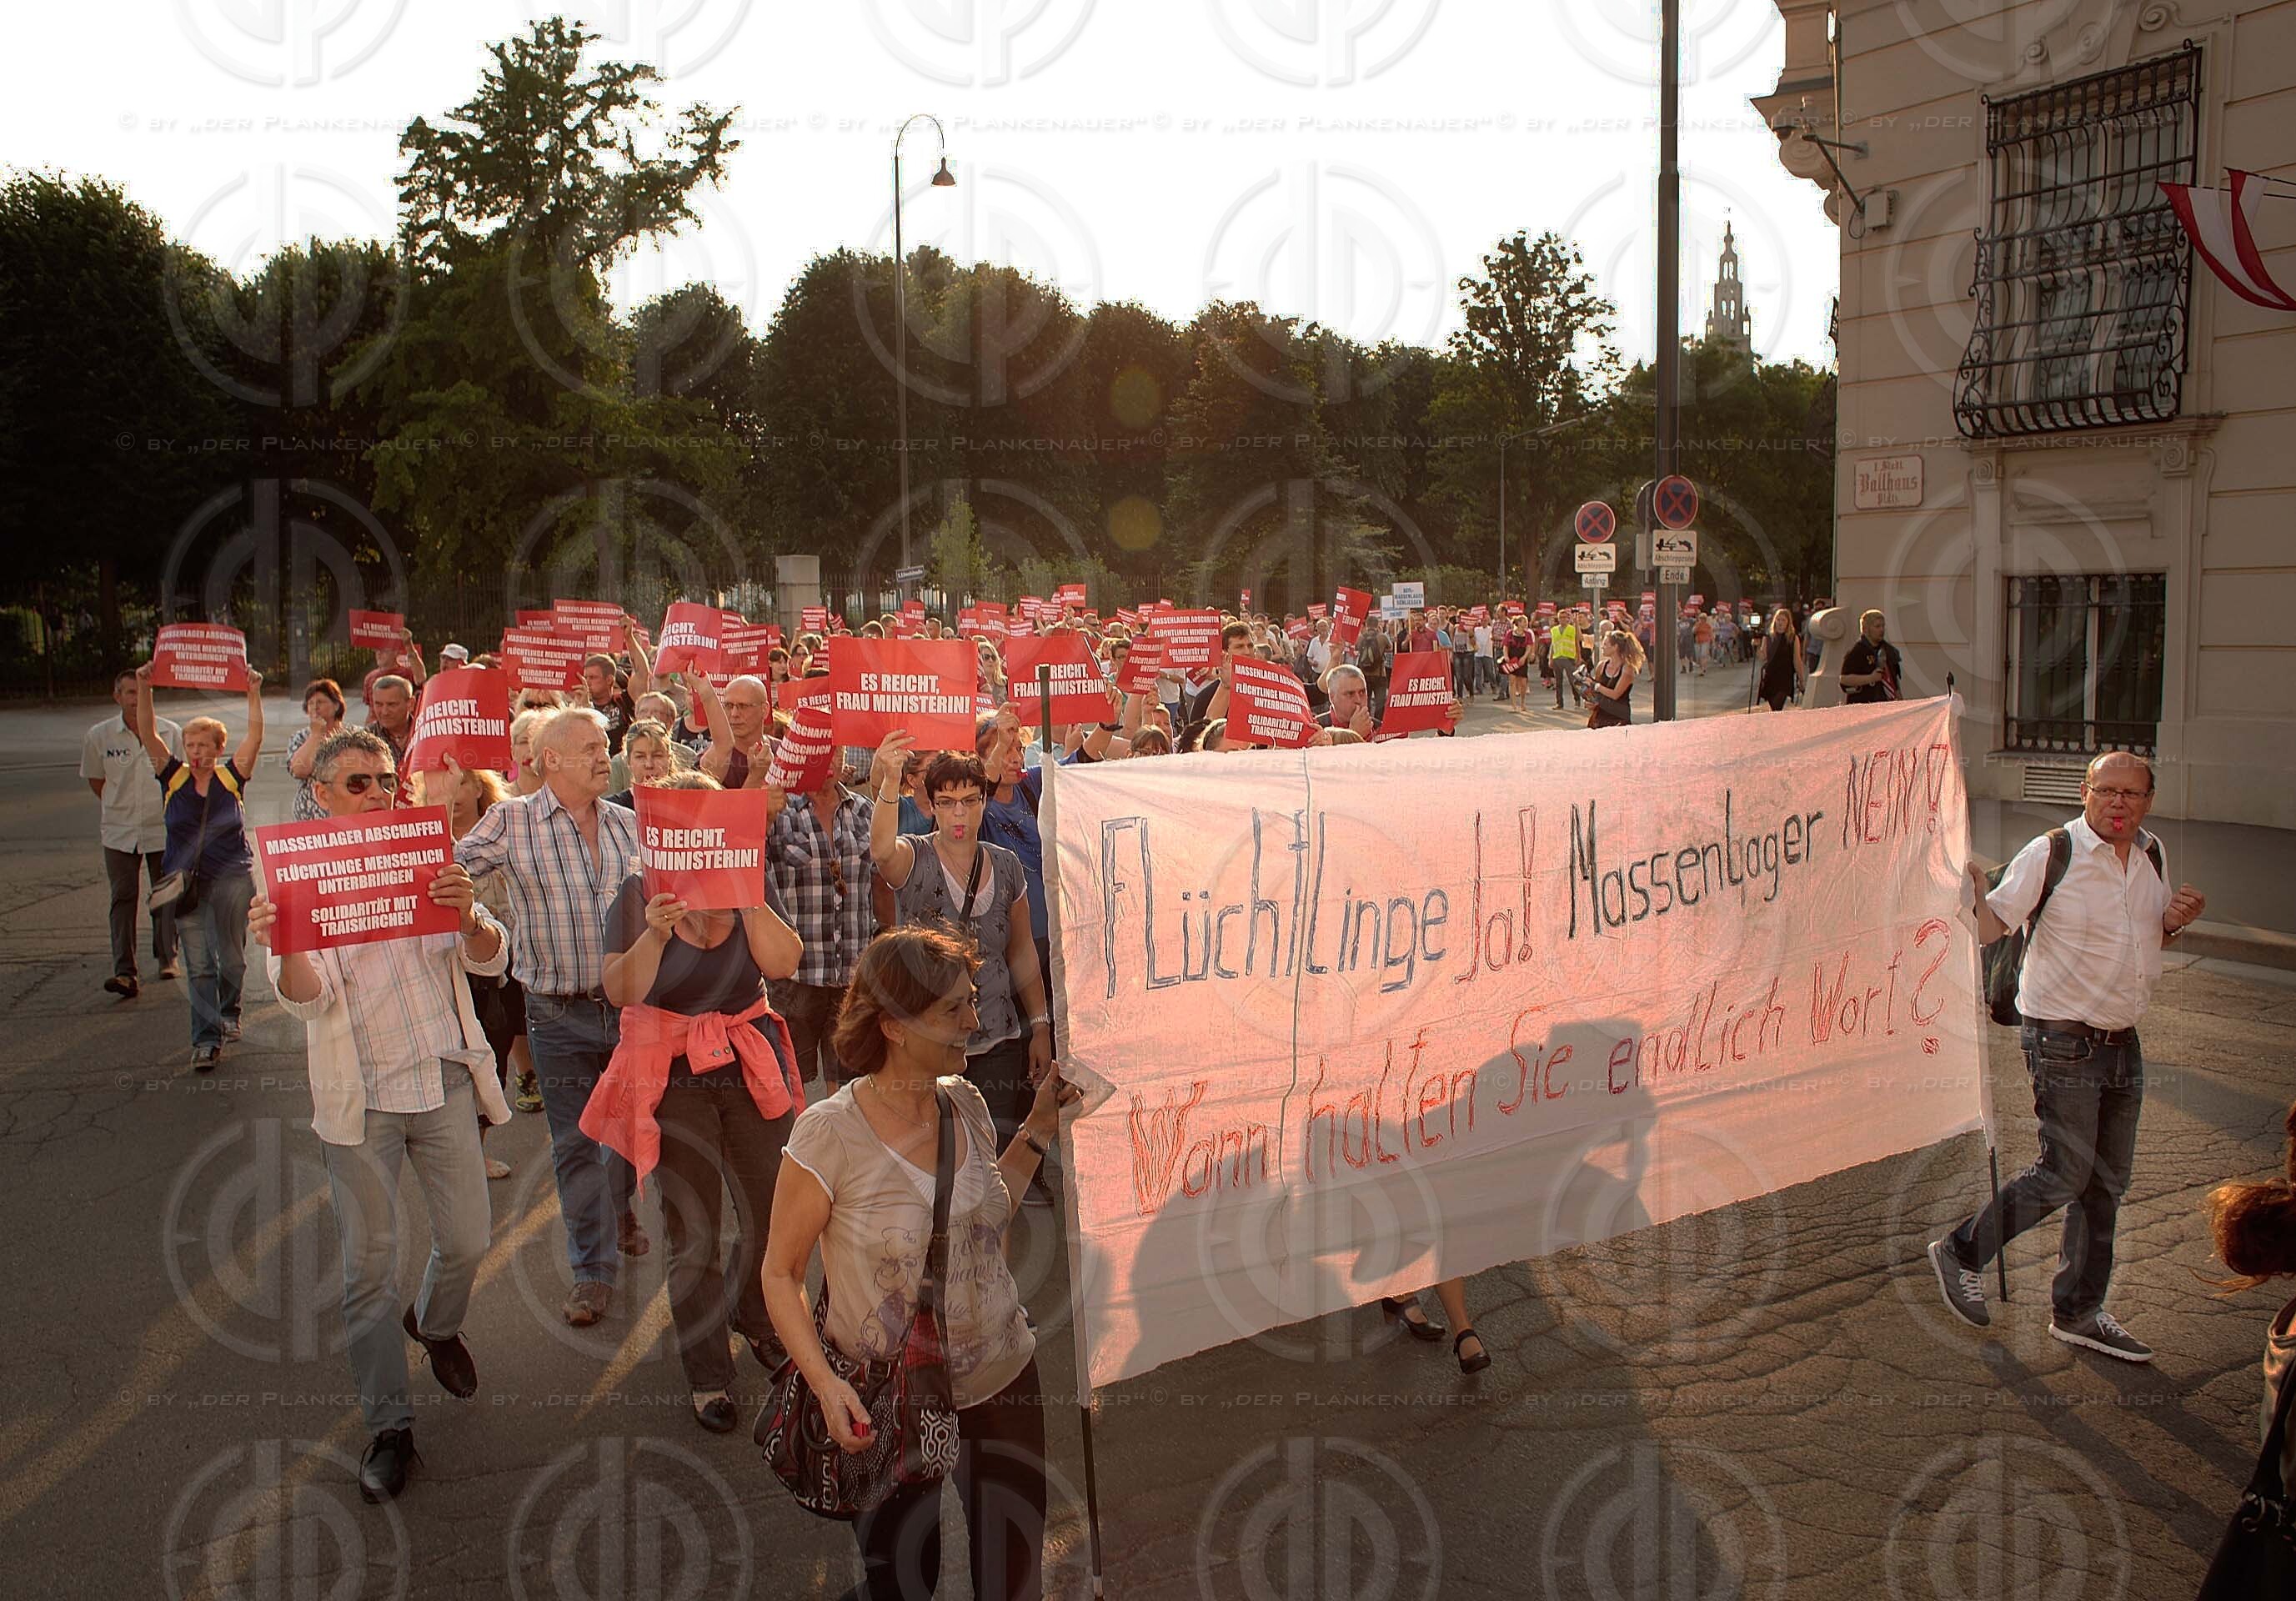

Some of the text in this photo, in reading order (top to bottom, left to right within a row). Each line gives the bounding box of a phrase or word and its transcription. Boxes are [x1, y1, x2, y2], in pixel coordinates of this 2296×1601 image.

[1050, 663, 1089, 680] REICHT,
[1235, 664, 1280, 682] MASSENLAGER
[860, 673, 940, 695] ES REICHT,
[1013, 682, 1041, 698] FRAU
[1236, 682, 1278, 700] FLÜCHTLINGE
[1407, 676, 1446, 692] ES REICHT,
[425, 699, 479, 722] REICHT,
[797, 697, 809, 708] ES
[836, 692, 870, 711] FRAU
[872, 693, 970, 714] MINISTERIN!
[1254, 697, 1302, 715] UNTERBRINGEN
[1389, 693, 1412, 708] FRAU
[419, 717, 505, 742] MINISTERIN!
[1247, 714, 1304, 732] SOLIDARITÄT MIT
[1251, 725, 1300, 740] TRAISKIRCHEN
[265, 820, 444, 856] MASSENLAGER ABSCHAFFEN
[662, 826, 727, 850] REICHT,
[275, 848, 445, 884] FLÜCHTLINGE MENSCHLICH
[654, 847, 759, 871] MINISTERIN!
[317, 868, 414, 895] UNTERBRINGEN
[1454, 805, 1537, 984] Ja!
[310, 895, 419, 924] SOLIDARITÄT MIT
[319, 910, 414, 937] TRAISKIRCHEN
[1127, 1080, 1269, 1217] Wann
[1497, 1005, 1574, 1115] Sie
